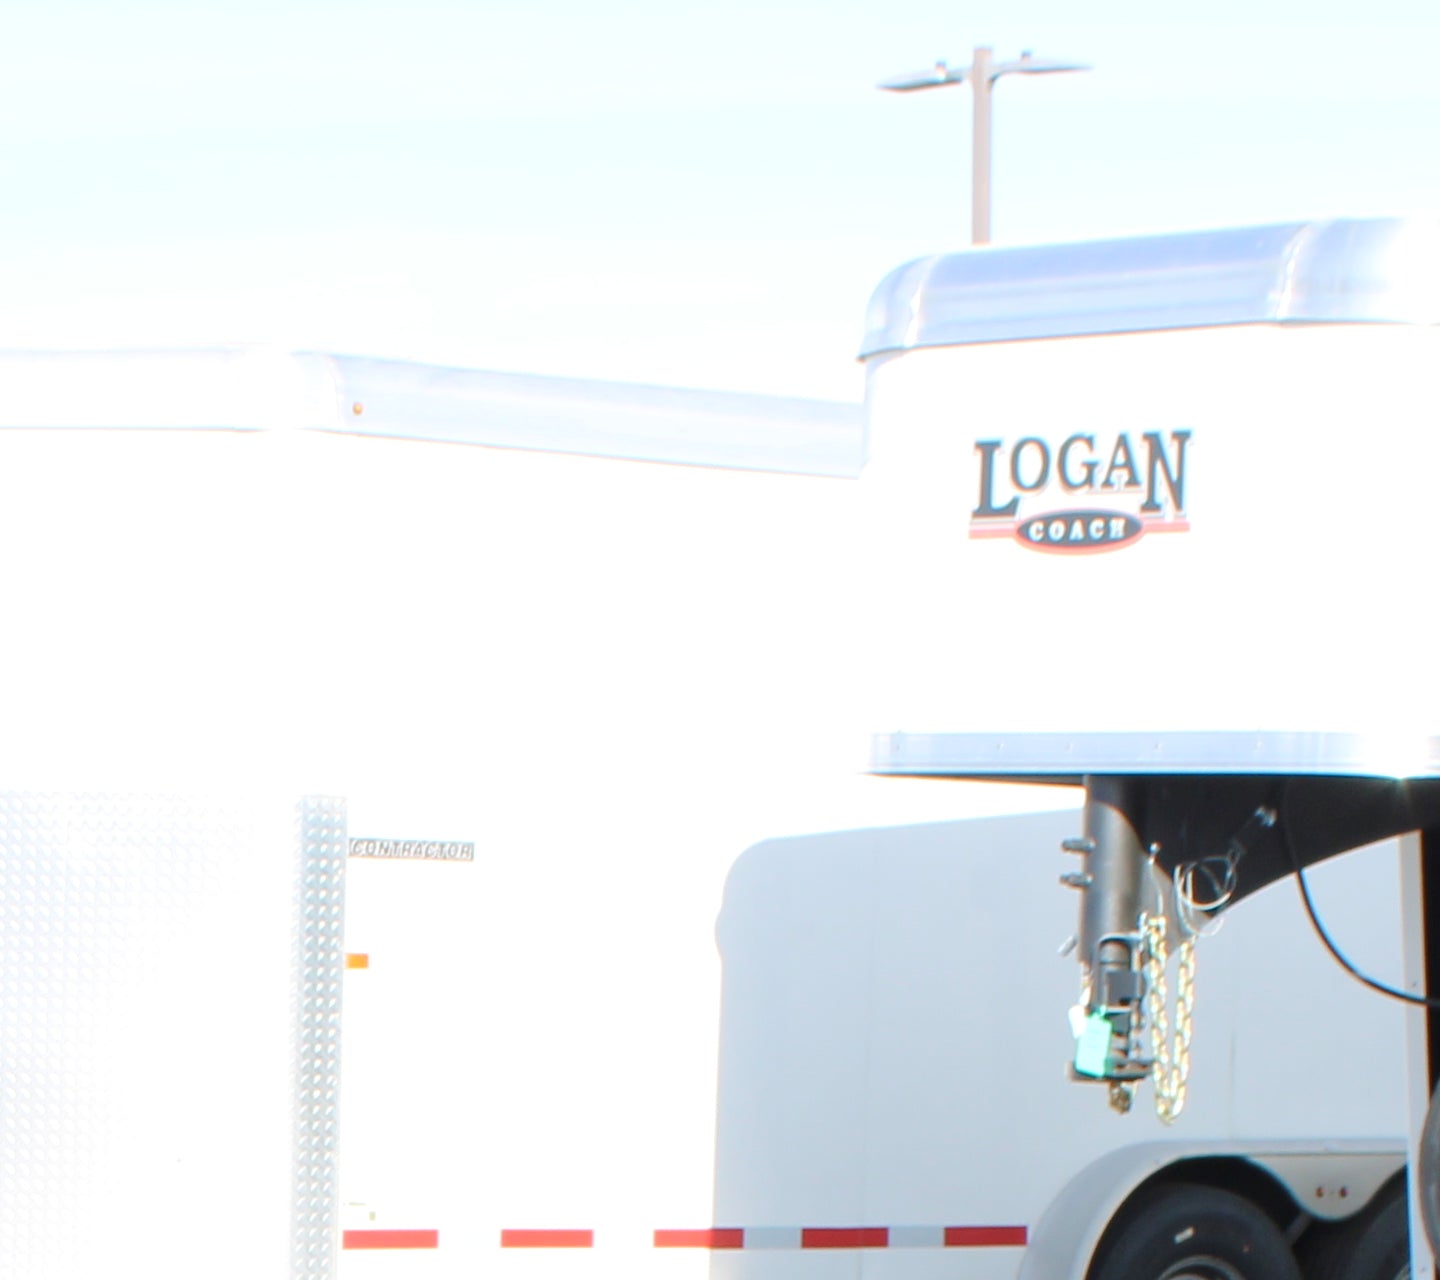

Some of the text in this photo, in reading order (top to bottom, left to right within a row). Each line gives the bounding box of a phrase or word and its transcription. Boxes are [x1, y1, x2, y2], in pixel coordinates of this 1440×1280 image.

[970, 429, 1193, 519] LOGAN
[1027, 516, 1127, 542] COACH
[350, 838, 474, 861] CONTRACTOR
